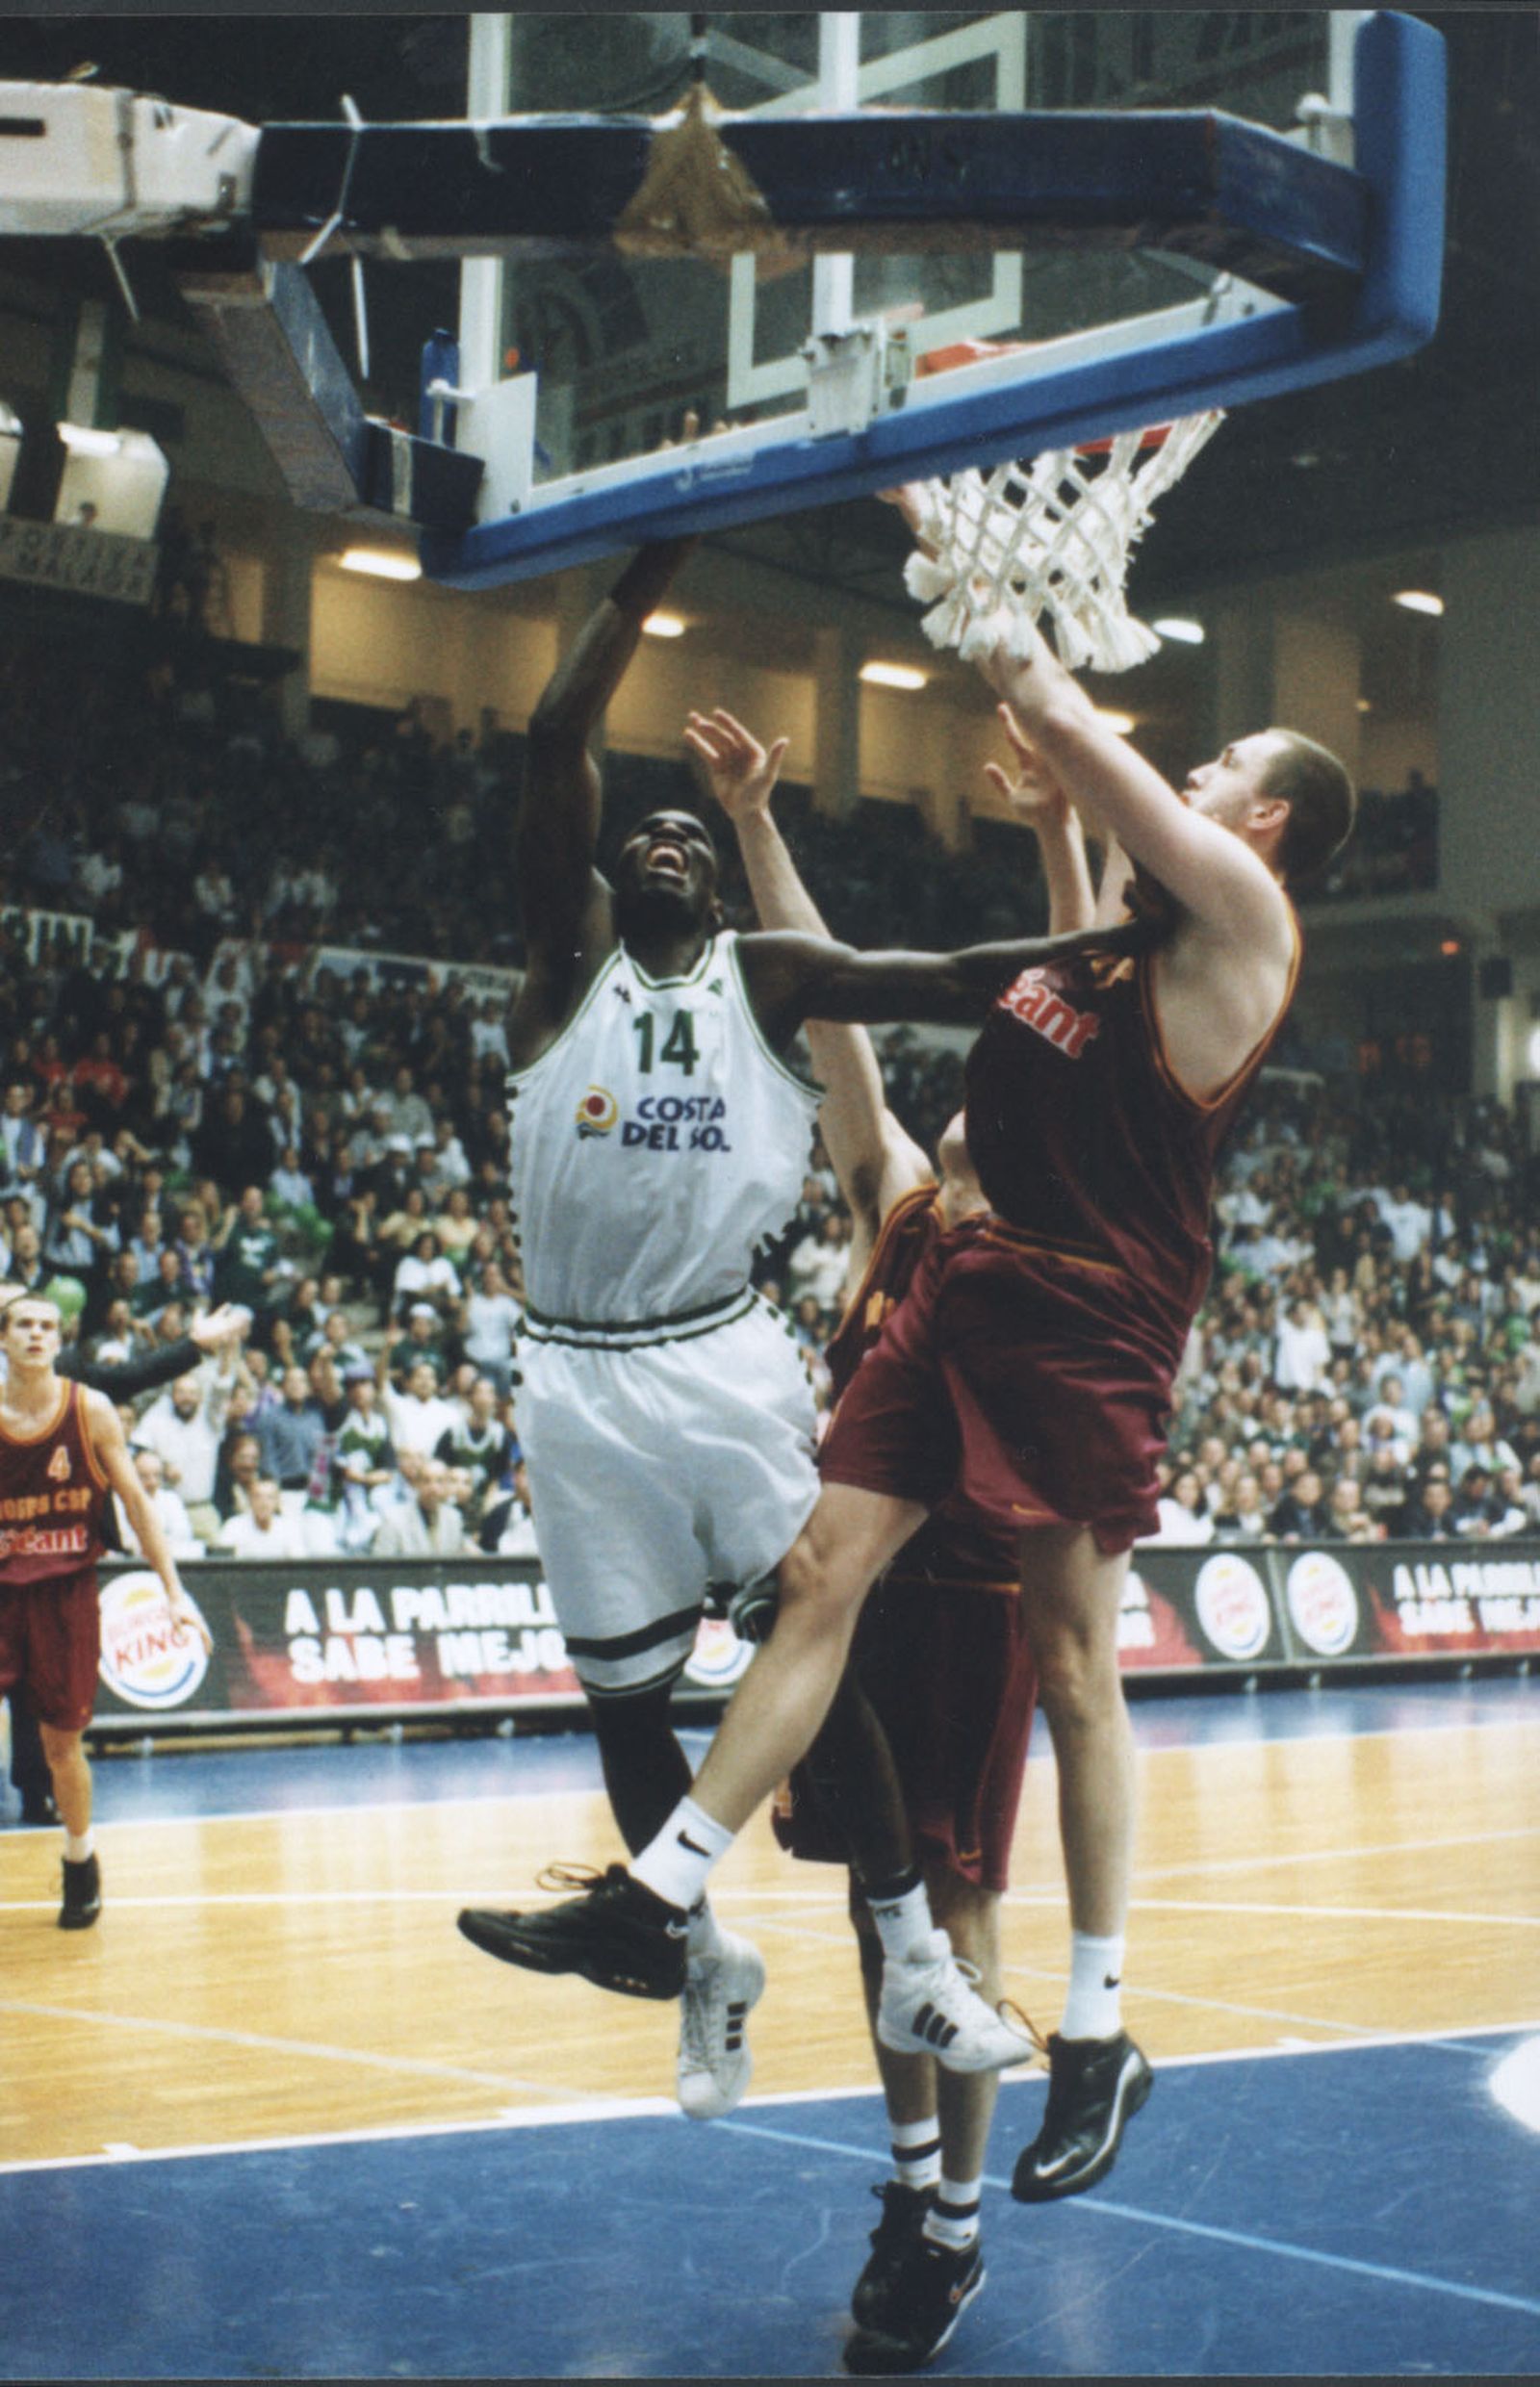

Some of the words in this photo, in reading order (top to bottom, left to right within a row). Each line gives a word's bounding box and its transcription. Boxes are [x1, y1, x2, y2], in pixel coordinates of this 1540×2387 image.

[997, 966, 1099, 1058] éant
[632, 1009, 700, 1076] 14
[636, 1095, 727, 1122] COSTA
[621, 1120, 680, 1151] DEL
[47, 1445, 72, 1482] 4
[285, 1588, 321, 1633] A
[324, 1587, 387, 1632] LA
[391, 1582, 560, 1630] PARRILL
[115, 1628, 192, 1674] KING
[289, 1634, 423, 1682] SABE
[437, 1628, 575, 1678] MEJO
